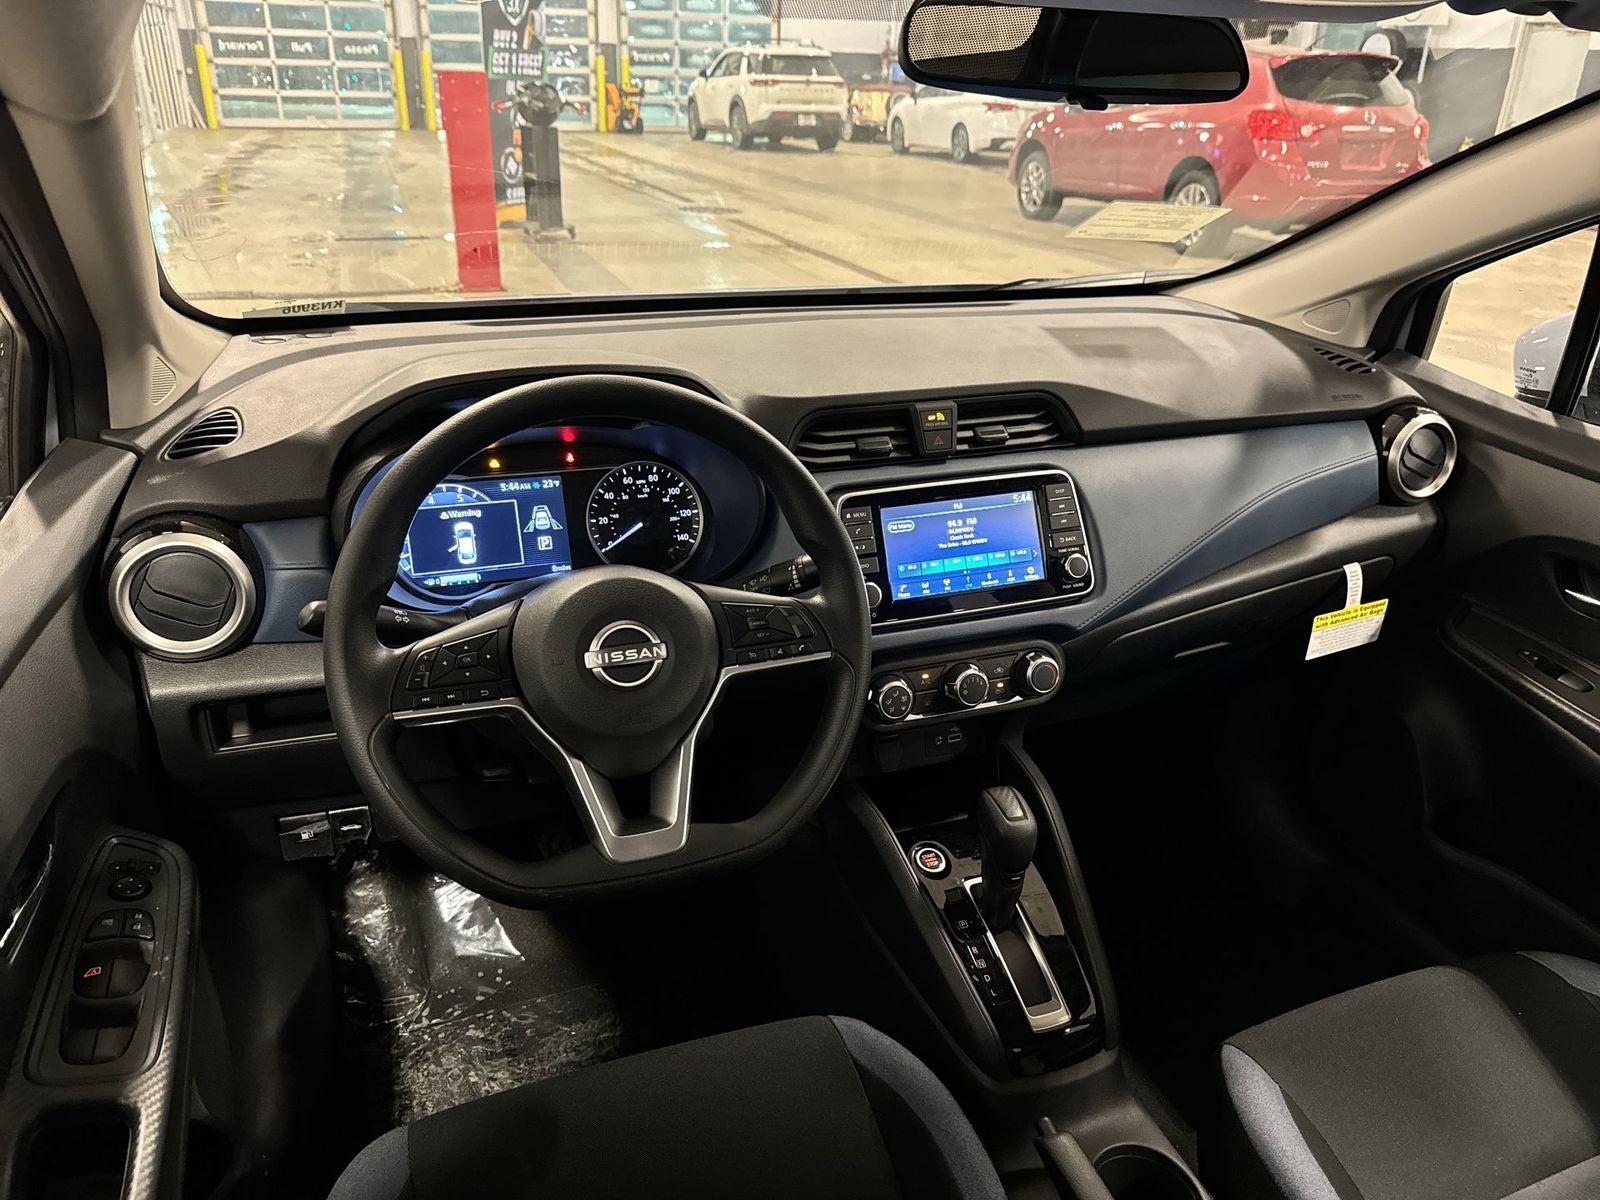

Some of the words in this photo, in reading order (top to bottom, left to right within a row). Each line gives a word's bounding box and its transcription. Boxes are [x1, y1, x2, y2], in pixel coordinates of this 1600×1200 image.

[622, 476, 633, 485] 60
[648, 474, 659, 482] 80
[667, 487, 681, 495] 100
[456, 493, 465, 502] 5
[603, 492, 614, 500] 40
[1013, 492, 1032, 503] 5:44
[448, 509, 482, 519] Warning
[680, 509, 691, 517] 120
[598, 516, 609, 524] 20
[677, 533, 689, 541] 140
[1330, 610, 1352, 619] Vehicle
[1360, 601, 1386, 612] Equipped
[1330, 613, 1358, 625] Advanced
[590, 647, 665, 664] NISSAN
[984, 974, 991, 982] D
[990, 988, 997, 997] L
